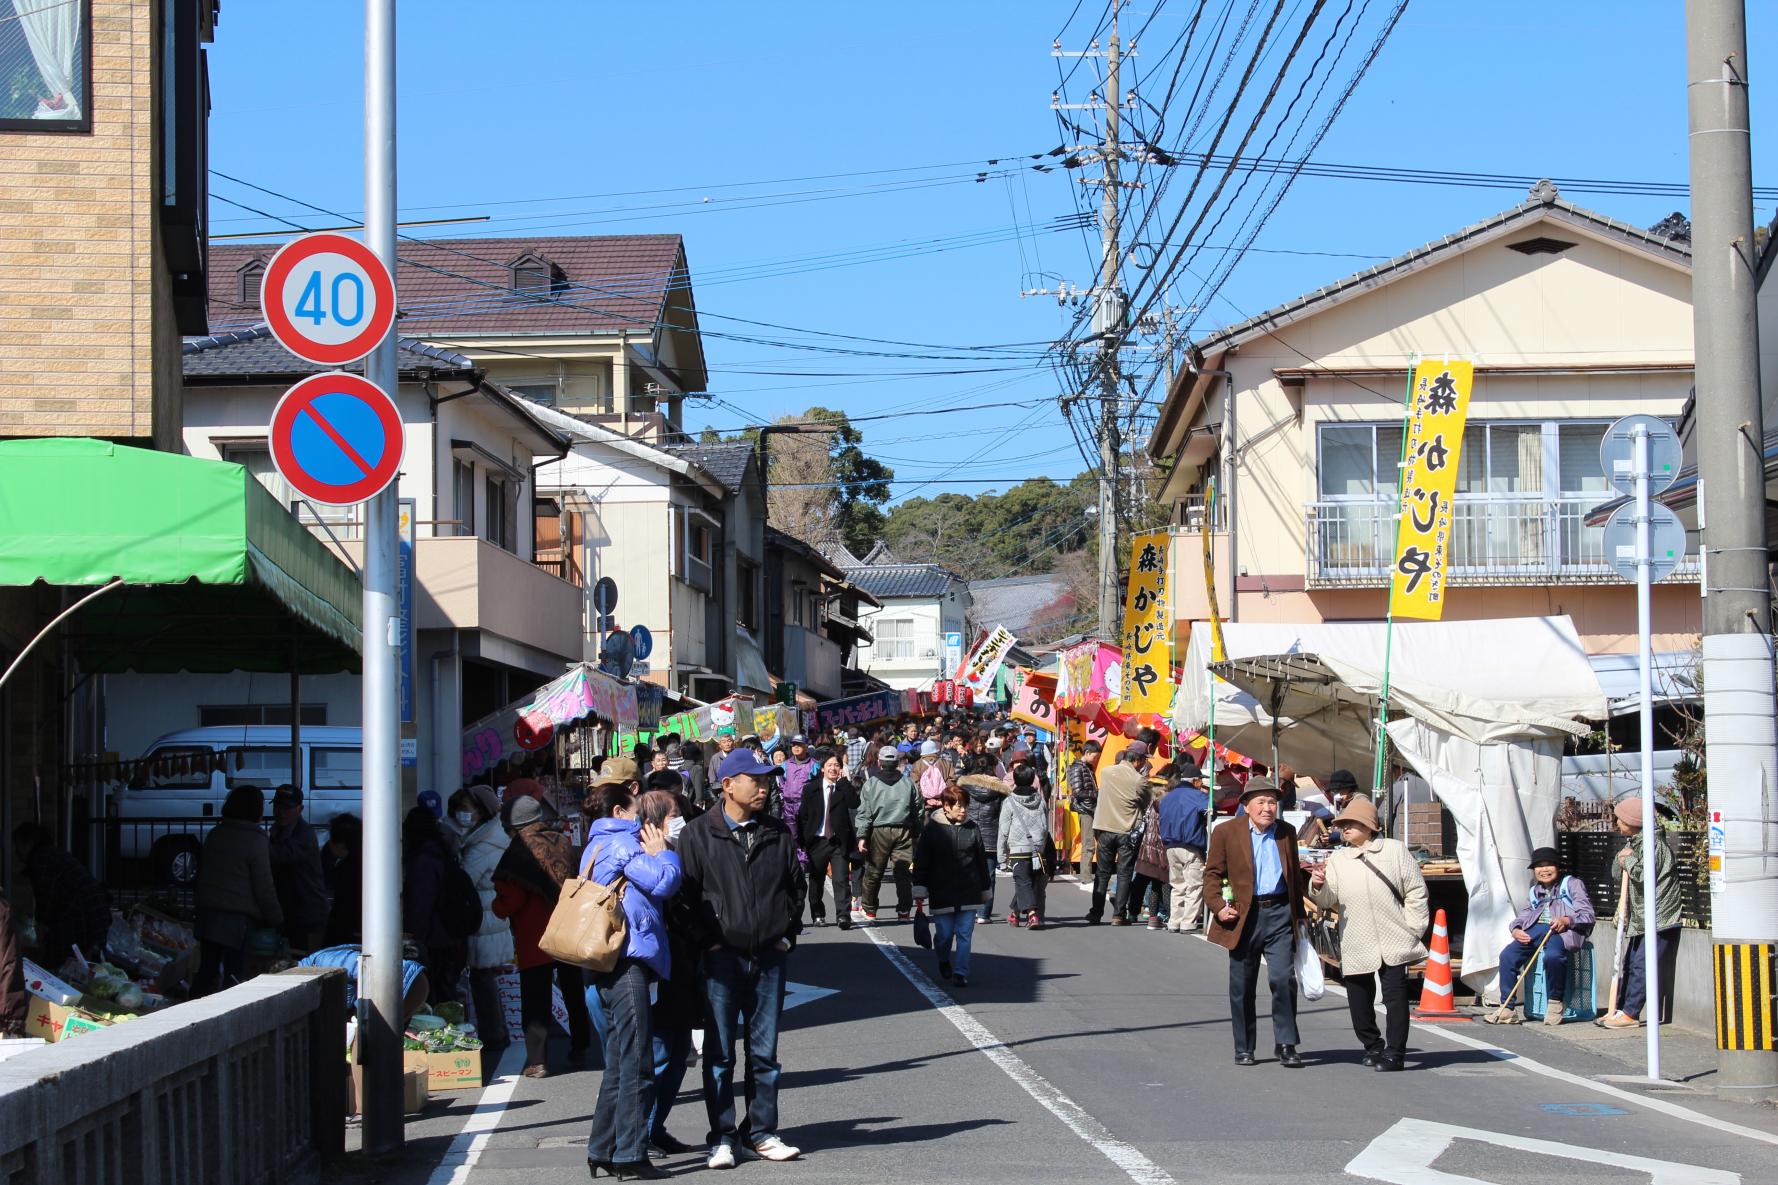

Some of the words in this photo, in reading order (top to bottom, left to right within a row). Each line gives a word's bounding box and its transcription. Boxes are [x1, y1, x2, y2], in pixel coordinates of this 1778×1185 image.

[294, 270, 364, 326] 40
[1132, 543, 1158, 697] 森かじや
